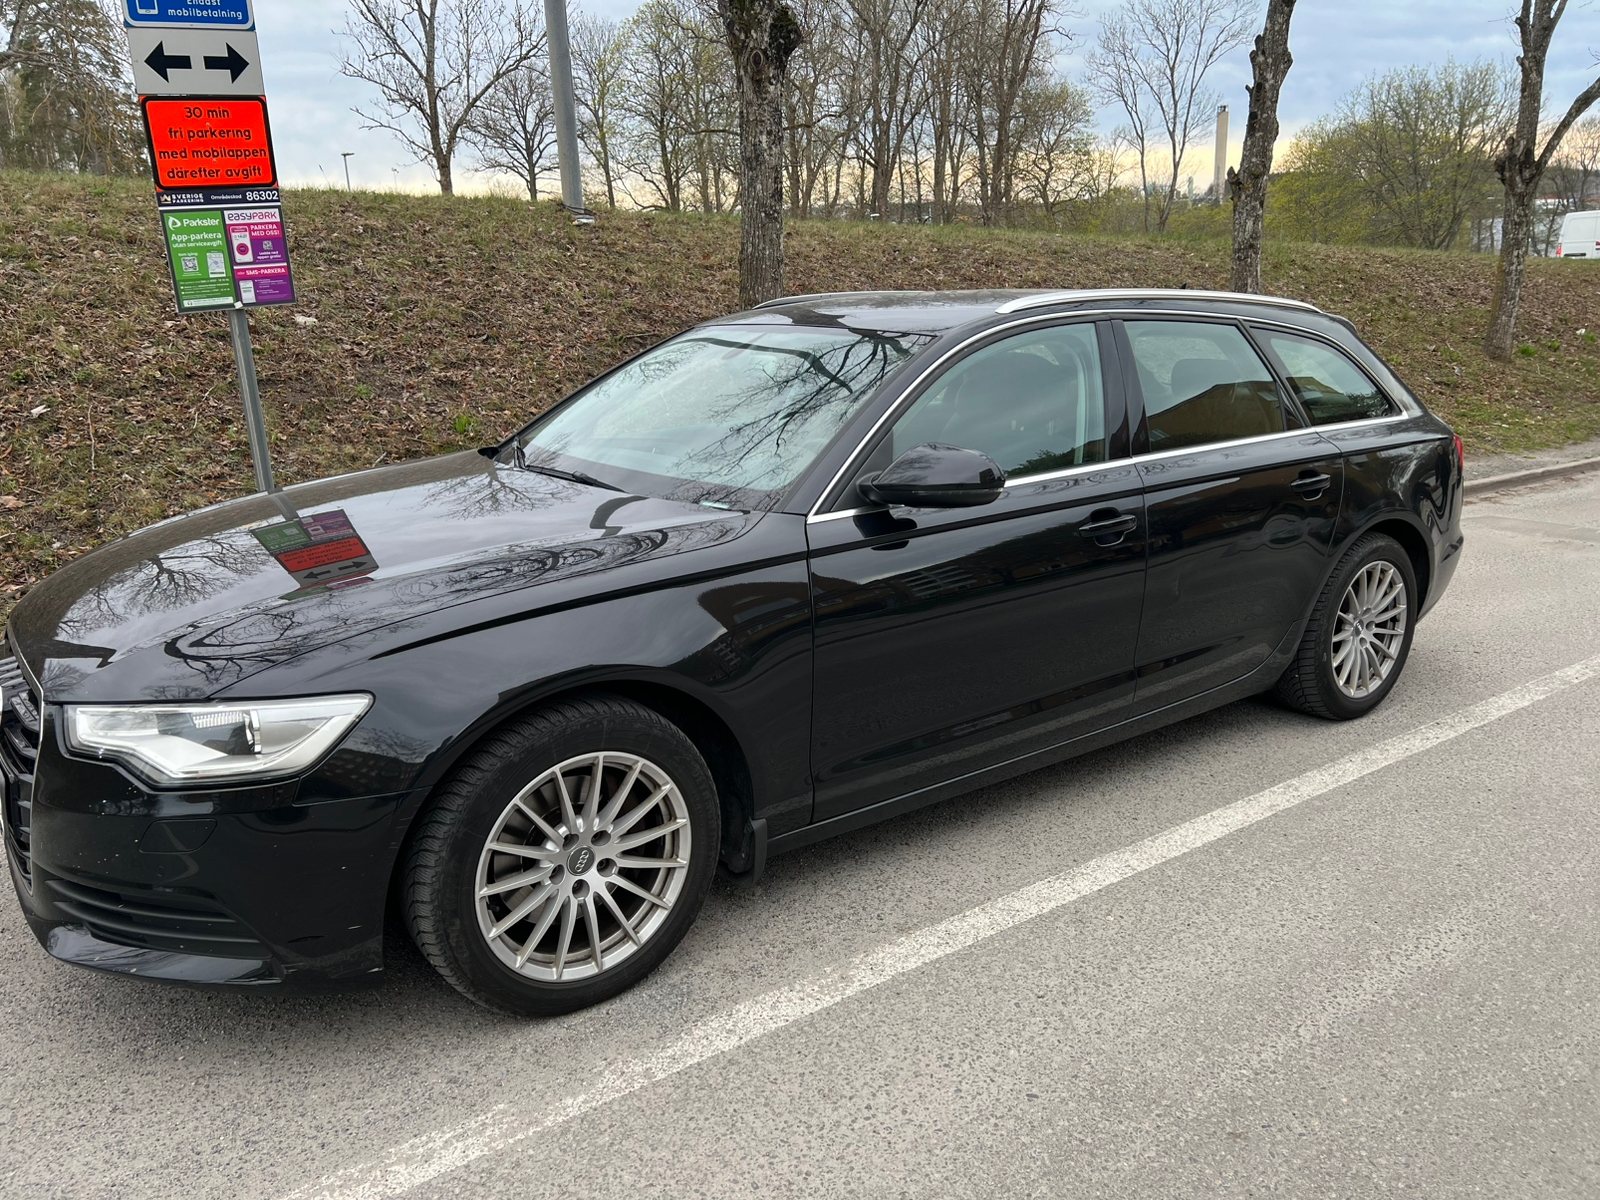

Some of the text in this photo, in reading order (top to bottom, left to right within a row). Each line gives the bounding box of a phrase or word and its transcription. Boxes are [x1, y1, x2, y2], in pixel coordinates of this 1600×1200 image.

[168, 8, 243, 20] mobilbetalning
[185, 107, 230, 119] 30 min
[168, 127, 252, 141] fri parkering
[159, 147, 267, 161] med mobilappen
[167, 166, 262, 180] därefter avgift
[246, 191, 279, 201] 86302
[183, 217, 220, 227] Parkster
[171, 232, 222, 242] App-parkera
[187, 240, 223, 248] serviceavgift
